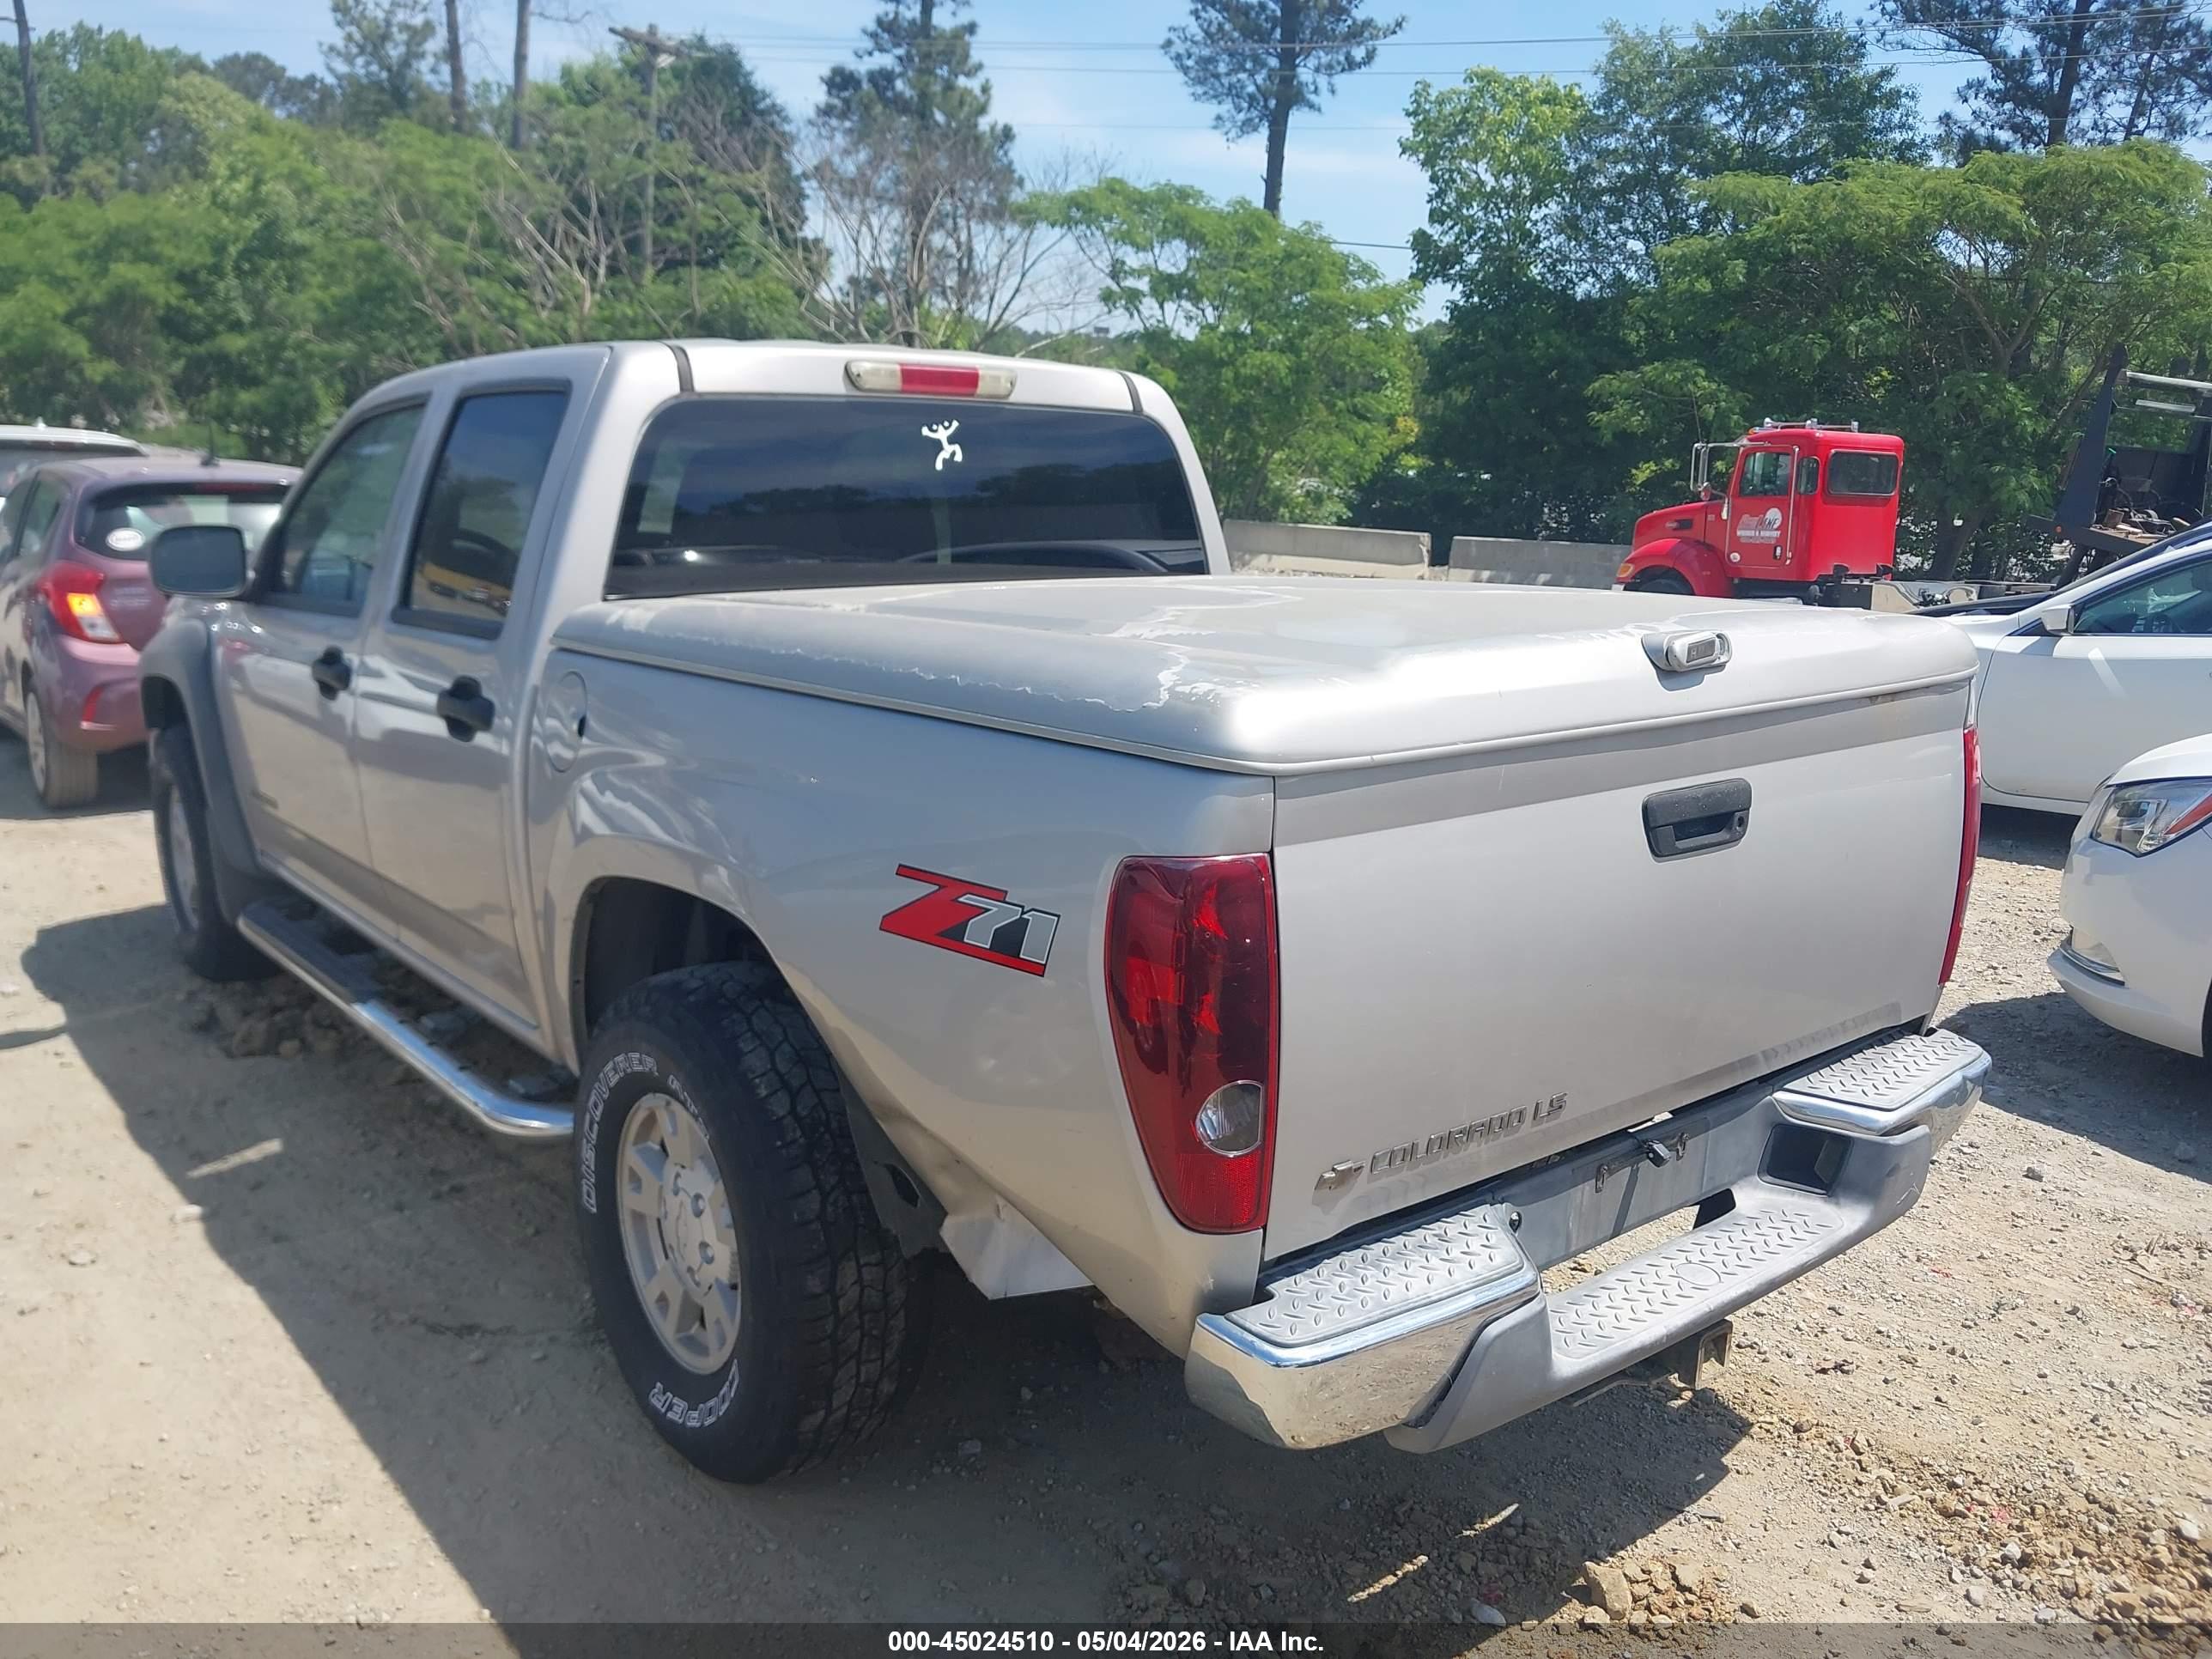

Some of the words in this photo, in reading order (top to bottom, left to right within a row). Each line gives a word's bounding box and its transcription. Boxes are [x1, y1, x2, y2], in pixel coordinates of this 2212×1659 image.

[879, 863, 1060, 977] Z71
[581, 1052, 659, 1213] DISCOVERER
[1370, 1105, 1527, 1176] COLORADO
[1533, 1091, 1568, 1121] LS
[648, 1358, 739, 1427] COOPER
